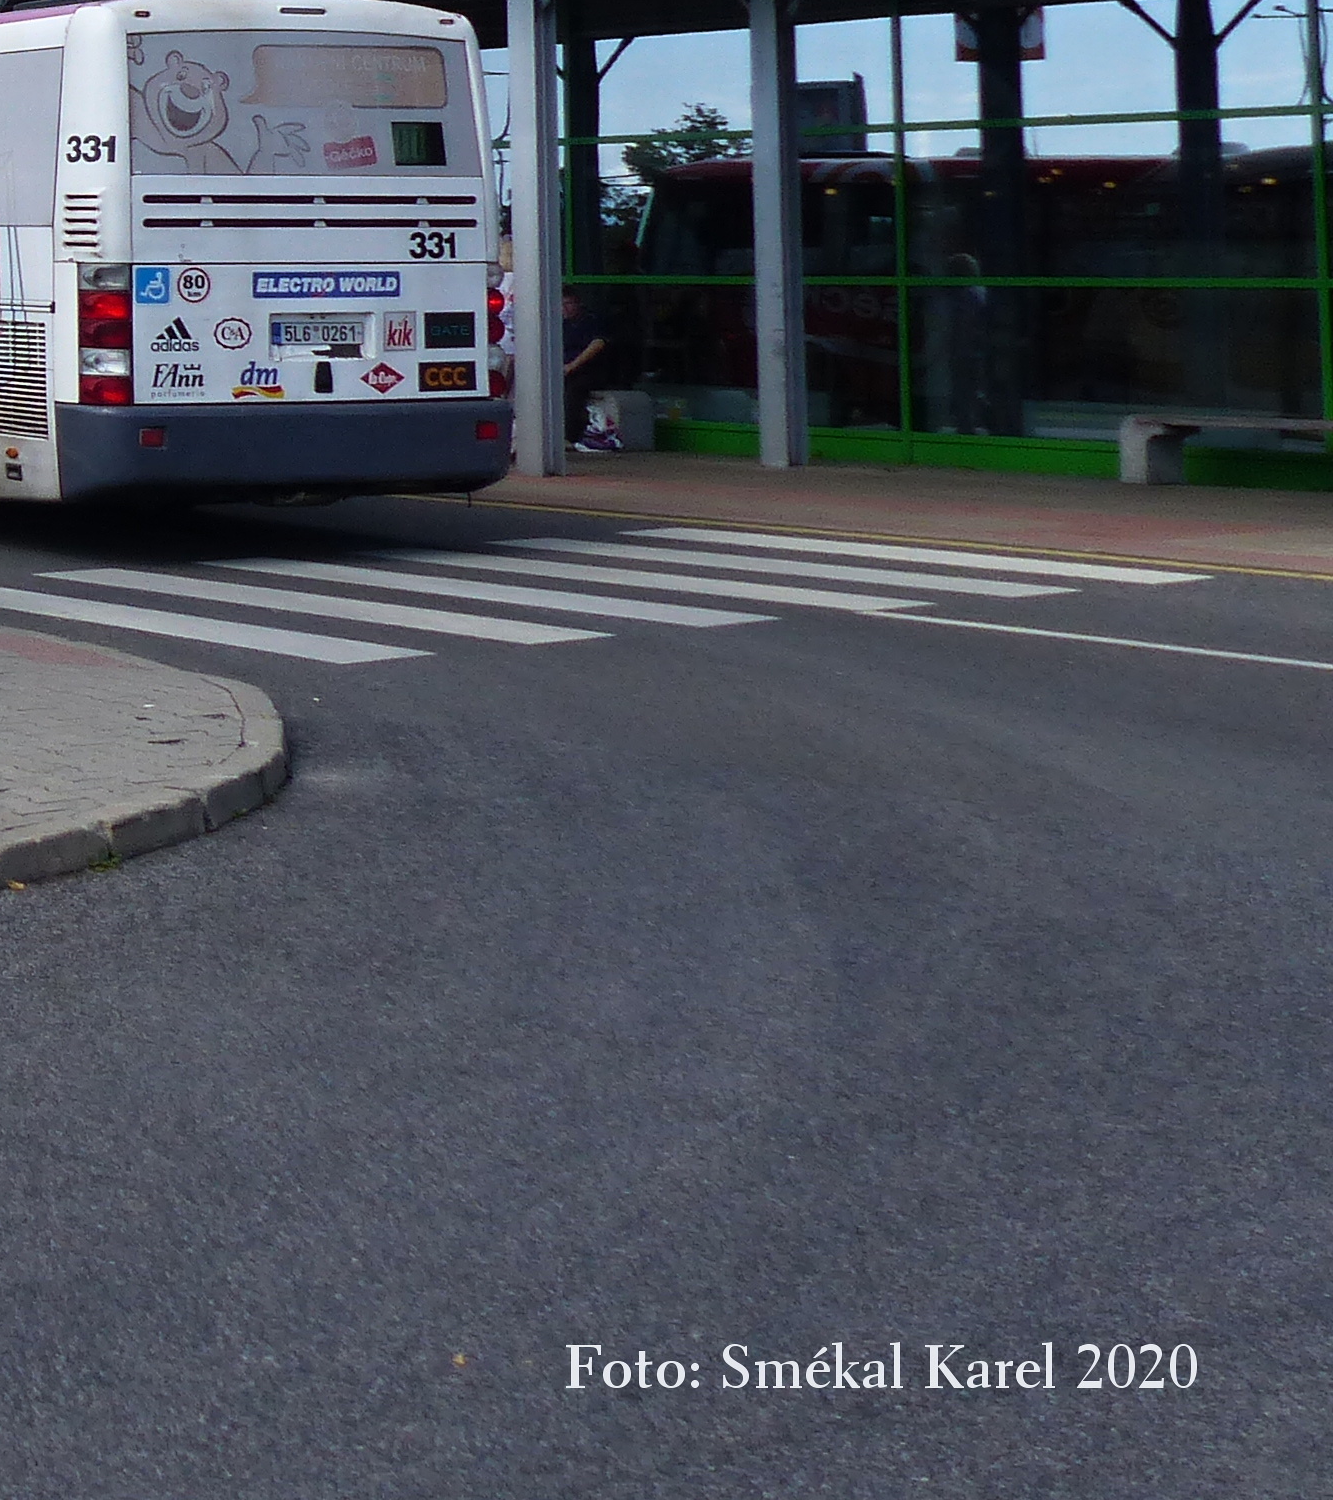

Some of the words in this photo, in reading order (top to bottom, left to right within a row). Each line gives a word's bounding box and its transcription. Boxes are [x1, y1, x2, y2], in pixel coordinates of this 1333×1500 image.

[65, 134, 117, 163] 331
[409, 231, 457, 259] 331
[183, 274, 206, 290] 80
[256, 276, 334, 293] ELECTRO
[339, 276, 398, 292] WORLD
[221, 326, 246, 342] C&A
[284, 325, 311, 343] 5L6
[321, 325, 357, 343] 0261
[387, 318, 413, 347] kik
[150, 338, 200, 352] adidas
[152, 363, 205, 389] FAnn
[240, 360, 279, 386] dm
[424, 366, 468, 387] CCC
